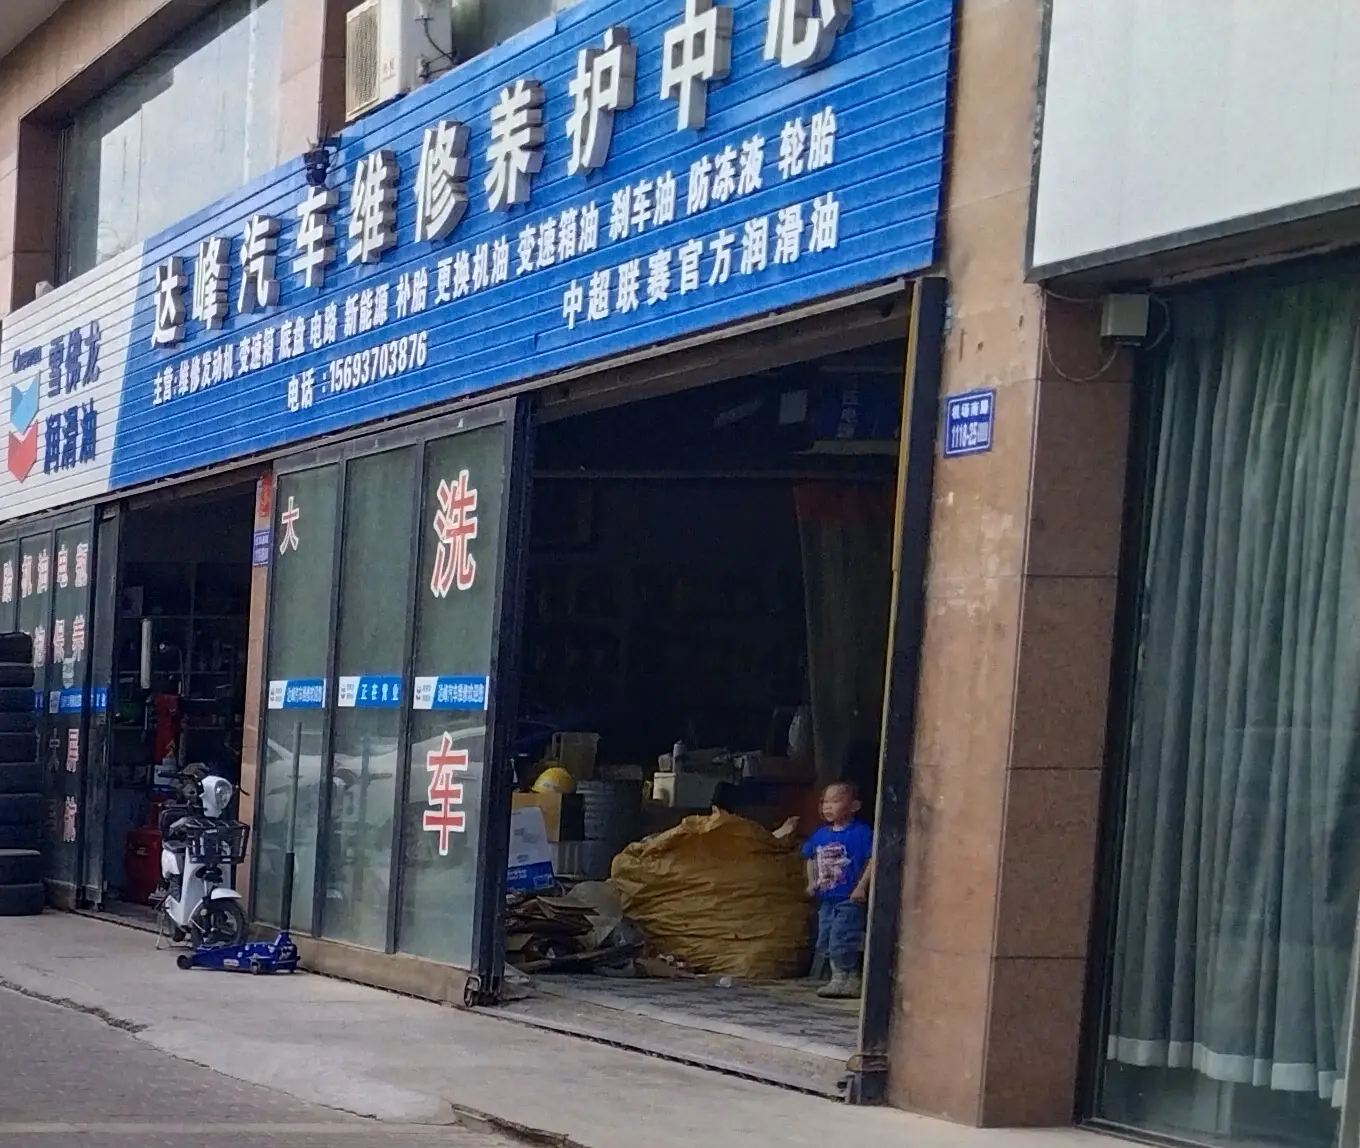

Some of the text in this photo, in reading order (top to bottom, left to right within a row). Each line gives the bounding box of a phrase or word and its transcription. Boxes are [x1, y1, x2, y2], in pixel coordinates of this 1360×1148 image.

[238, 328, 275, 374] 变速箱
[278, 315, 305, 360] 底盘
[310, 301, 337, 349] 电路
[344, 283, 389, 337] 新能源
[396, 267, 427, 318] 补胎
[434, 235, 509, 305] 更换机油
[516, 200, 599, 276] 变速箱油
[609, 170, 676, 241] 刹车油
[686, 135, 765, 214] 防冻液
[778, 105, 838, 180] 轮胎
[562, 192, 840, 330] 中超联赛官方润滑油
[48, 320, 102, 398] 雪佛龙
[43, 398, 98, 475] 润滑油
[280, 496, 299, 555] 大
